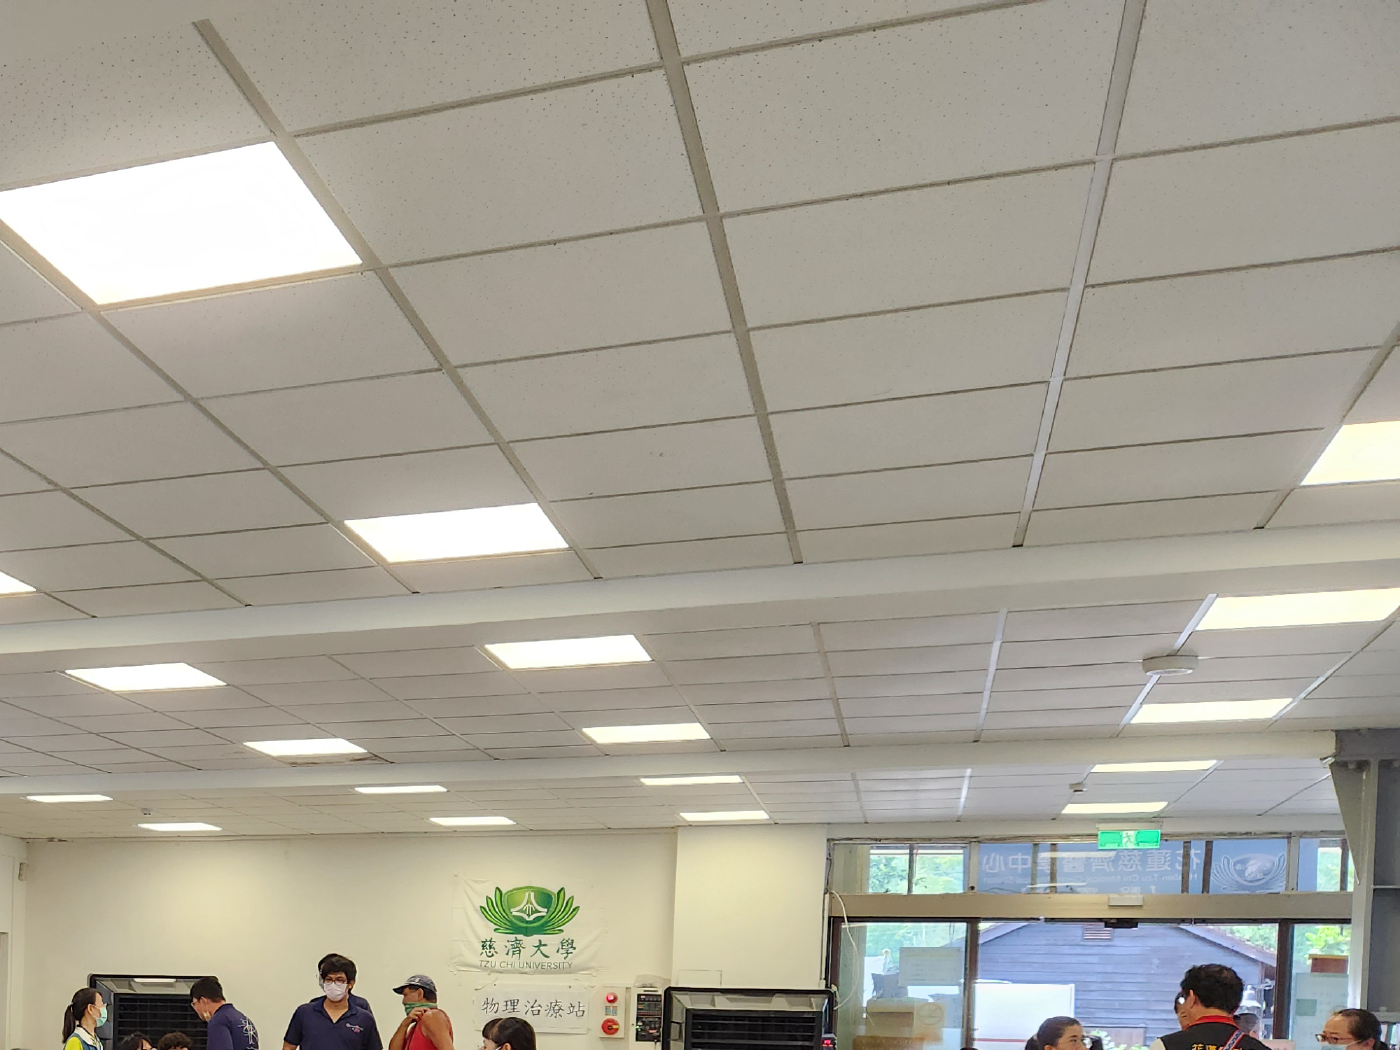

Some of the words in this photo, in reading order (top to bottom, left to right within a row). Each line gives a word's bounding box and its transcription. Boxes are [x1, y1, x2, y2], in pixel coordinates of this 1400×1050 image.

[480, 936, 577, 960] 慈濟大學
[479, 960, 497, 968] TZU
[500, 961, 516, 969] CHI
[518, 961, 574, 970] UNIVERSITY
[481, 997, 586, 1018] 物理治療站
